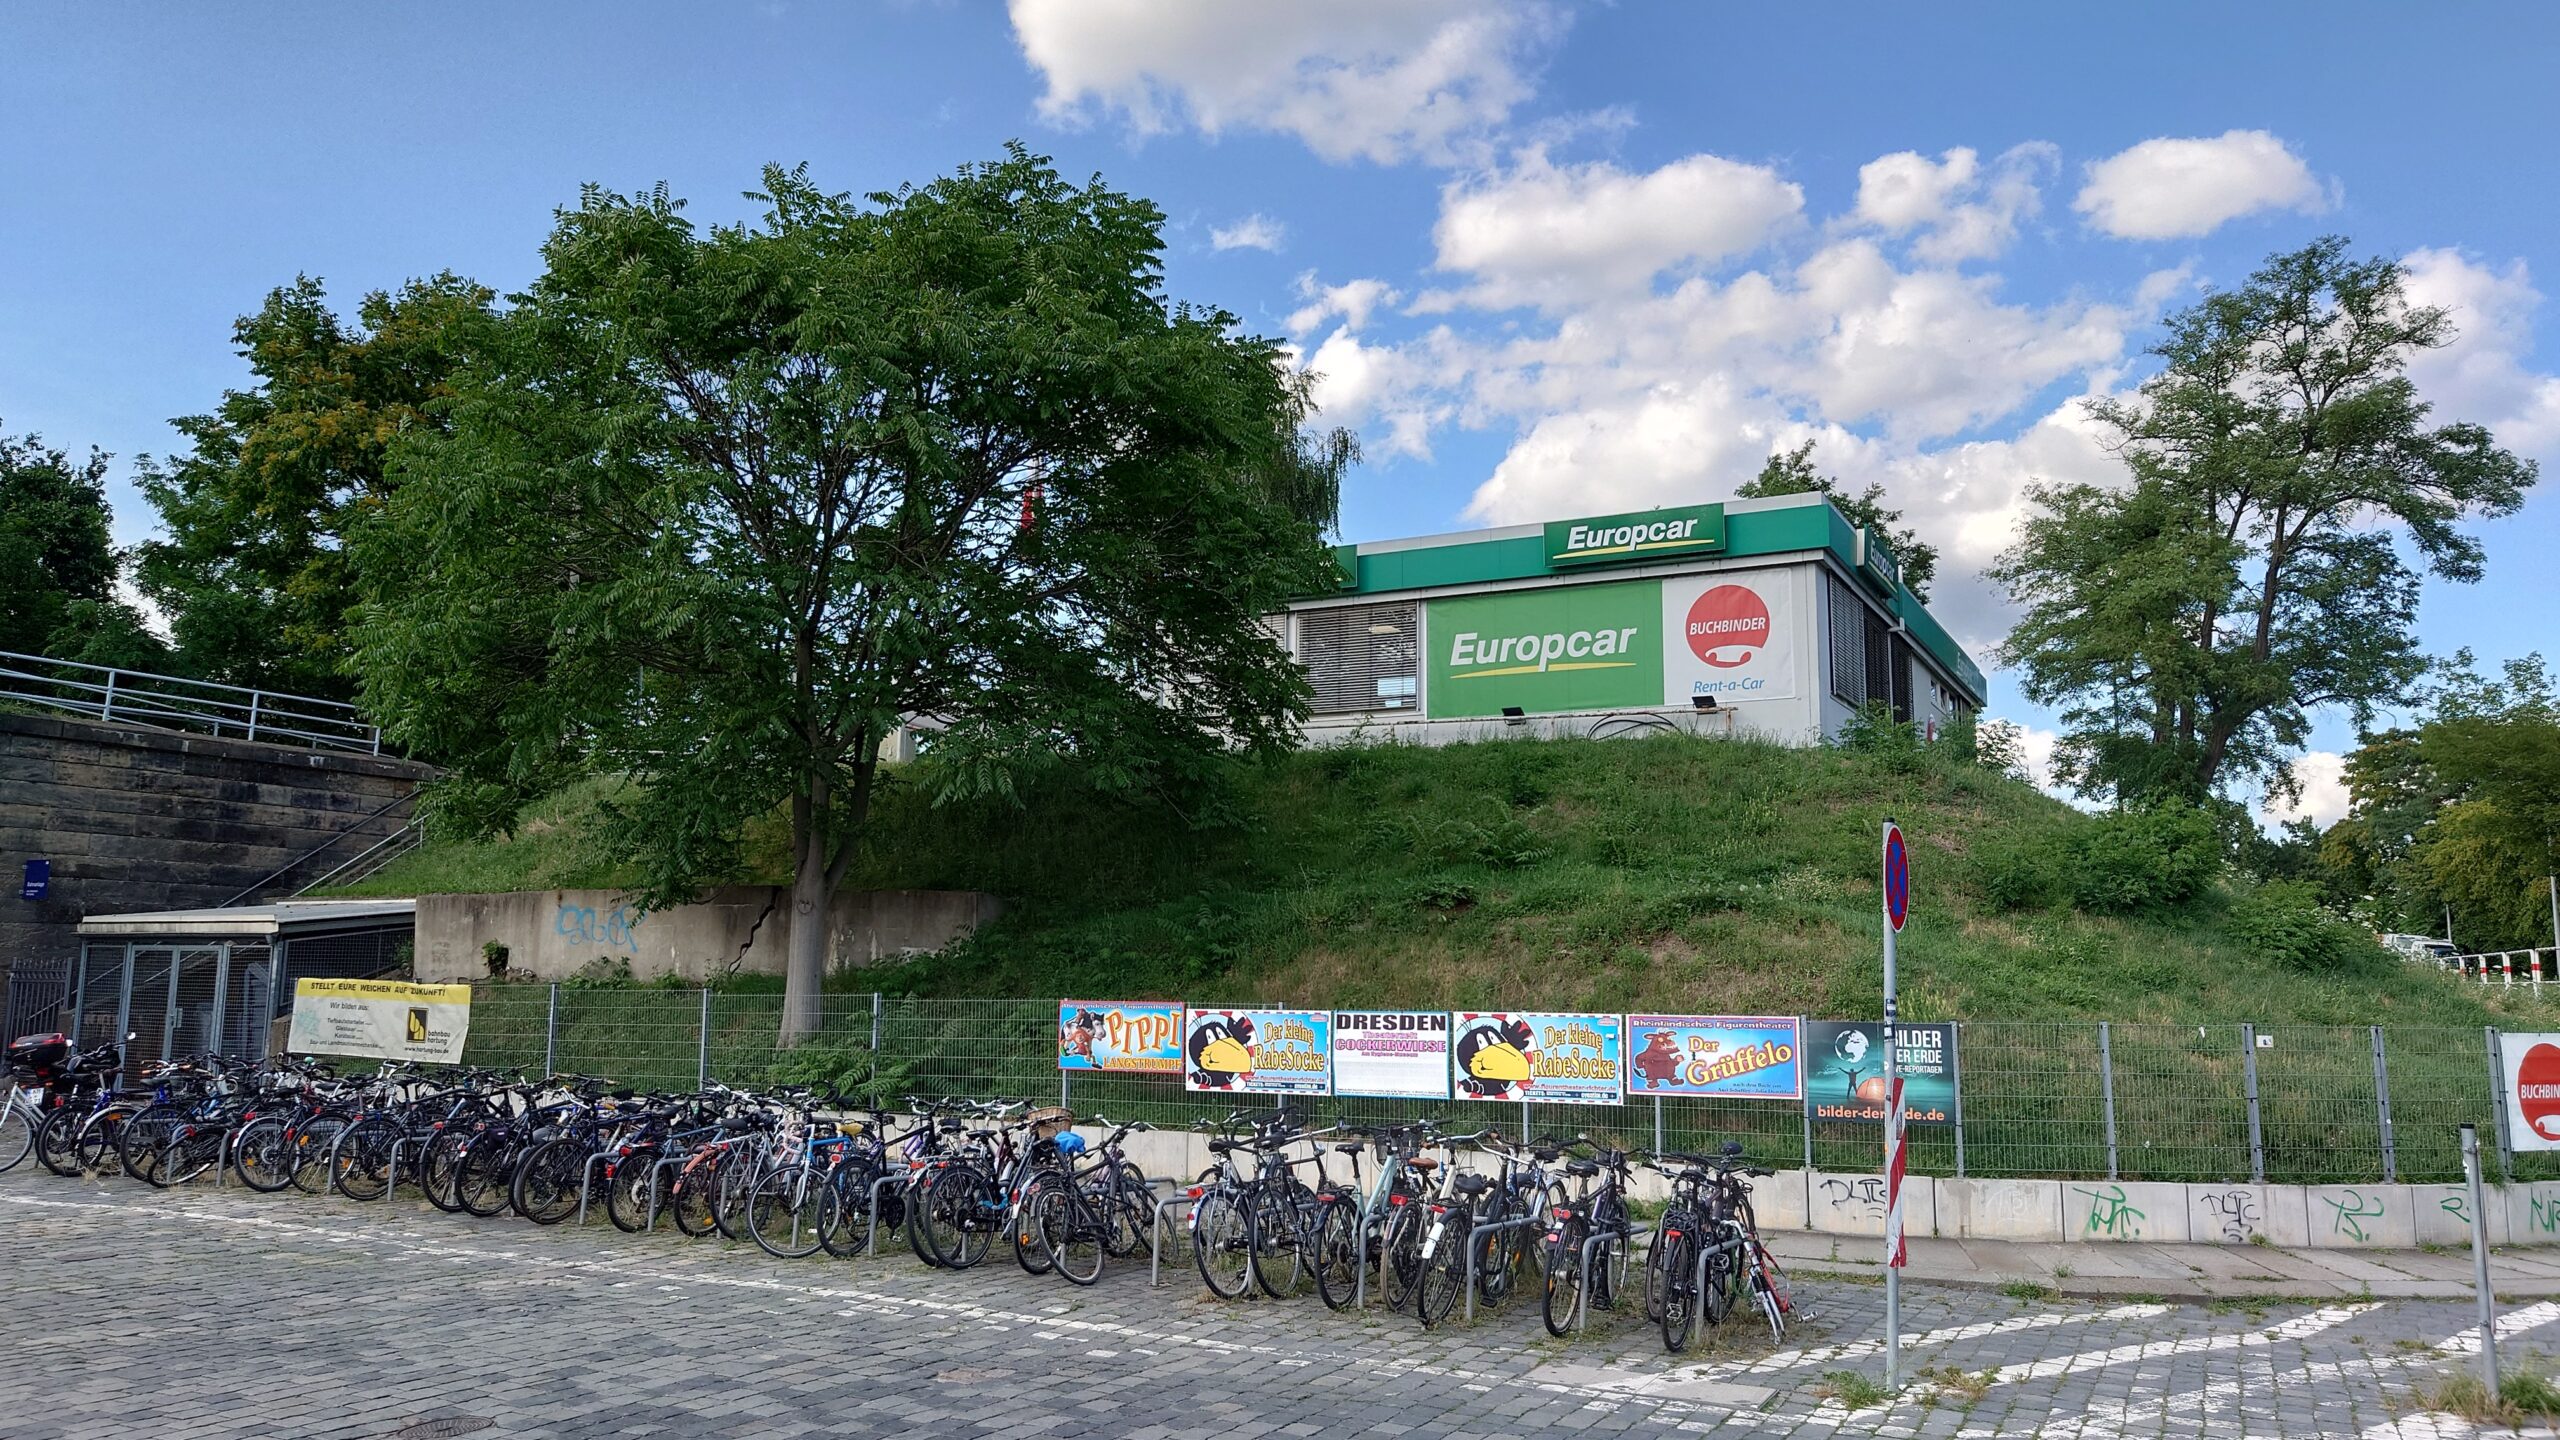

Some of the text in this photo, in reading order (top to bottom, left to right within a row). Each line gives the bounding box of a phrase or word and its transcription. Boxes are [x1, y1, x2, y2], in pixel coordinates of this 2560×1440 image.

[1567, 519, 1698, 551] Europcar
[1871, 538, 1895, 582] Europcar
[1690, 617, 1766, 635] BUCHBINDER
[1450, 627, 1638, 673] Europcar
[1693, 677, 1765, 694] Rent-a-Car
[310, 982, 446, 997] STELLT EURE WEICHEN AUF ZUKUNFT!
[341, 1002, 357, 1010] bilden
[1264, 1018, 1314, 1043] Der kleine
[1336, 1014, 1446, 1031] DRESDEN
[1633, 1019, 1793, 1031] Rheinländisches Figurentheater
[1105, 1010, 1181, 1055] PIPPI
[1544, 1023, 1603, 1049] Der kleine
[1335, 1038, 1446, 1053] COCKERWIESE
[1687, 1035, 1720, 1053] Der
[1103, 1057, 1182, 1071] LANGSTRUMPF
[1253, 1041, 1325, 1072] RabeSocke
[1533, 1047, 1616, 1080] RabeSocke
[1685, 1039, 1794, 1086] Grüffelo
[1914, 1050, 1942, 1063] ERDE
